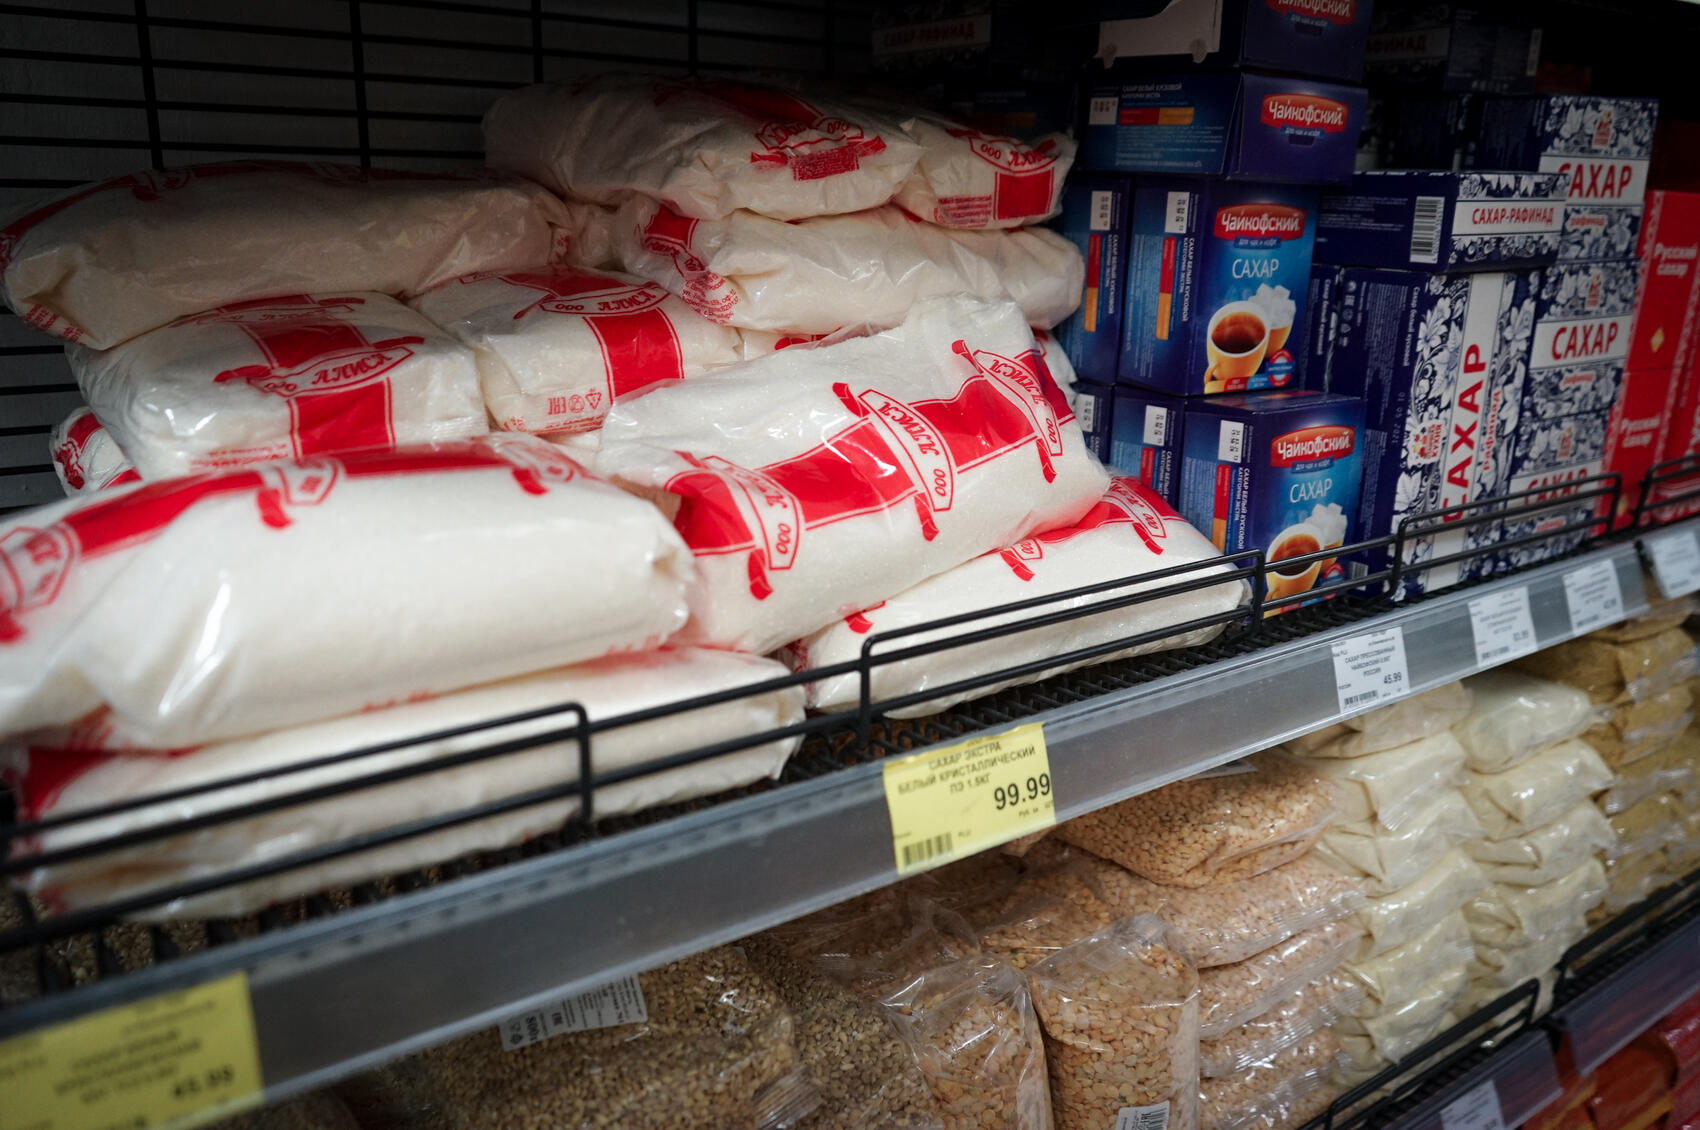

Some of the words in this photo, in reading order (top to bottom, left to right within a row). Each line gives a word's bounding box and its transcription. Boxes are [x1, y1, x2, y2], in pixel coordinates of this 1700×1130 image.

[1268, 99, 1344, 126] Чайкофский
[1221, 210, 1301, 236] Чайкофский
[1472, 207, 1553, 225] САХАР-РАФИНАД
[1187, 236, 1195, 260] САХАР
[1231, 258, 1280, 279] САХАР
[554, 303, 585, 312] ООО
[597, 290, 657, 311] АЛИСА
[1182, 285, 1191, 322] КУСКОВОЙ
[1551, 322, 1619, 361] САХАР
[311, 349, 394, 386] АЛИСА
[989, 358, 1049, 408] АЛИСА
[877, 401, 940, 457] АЛИСА
[1045, 417, 1058, 444] ООО
[1443, 343, 1487, 524] САХАР
[1483, 390, 1501, 471] рафинад
[1277, 431, 1351, 460] Чайкофский
[932, 468, 947, 497] ООО
[1243, 467, 1251, 490] САХАР
[1290, 478, 1332, 503] САХАР
[1241, 490, 1249, 514] БЕЛЫЙ
[775, 523, 792, 555] ООО
[1237, 514, 1247, 550] КУСКОВОЙ
[1383, 671, 1402, 684] 45.99
[898, 776, 937, 795] БЕЛЫЙ
[939, 744, 1036, 782] КРИСТАЛЛИЧЕСКИЙ
[928, 753, 963, 771] САХАР
[964, 741, 1001, 760] ЭКСТРА
[950, 781, 965, 794] ПЭ
[967, 773, 992, 788] 1.5КГ
[993, 773, 1050, 810] 99.99
